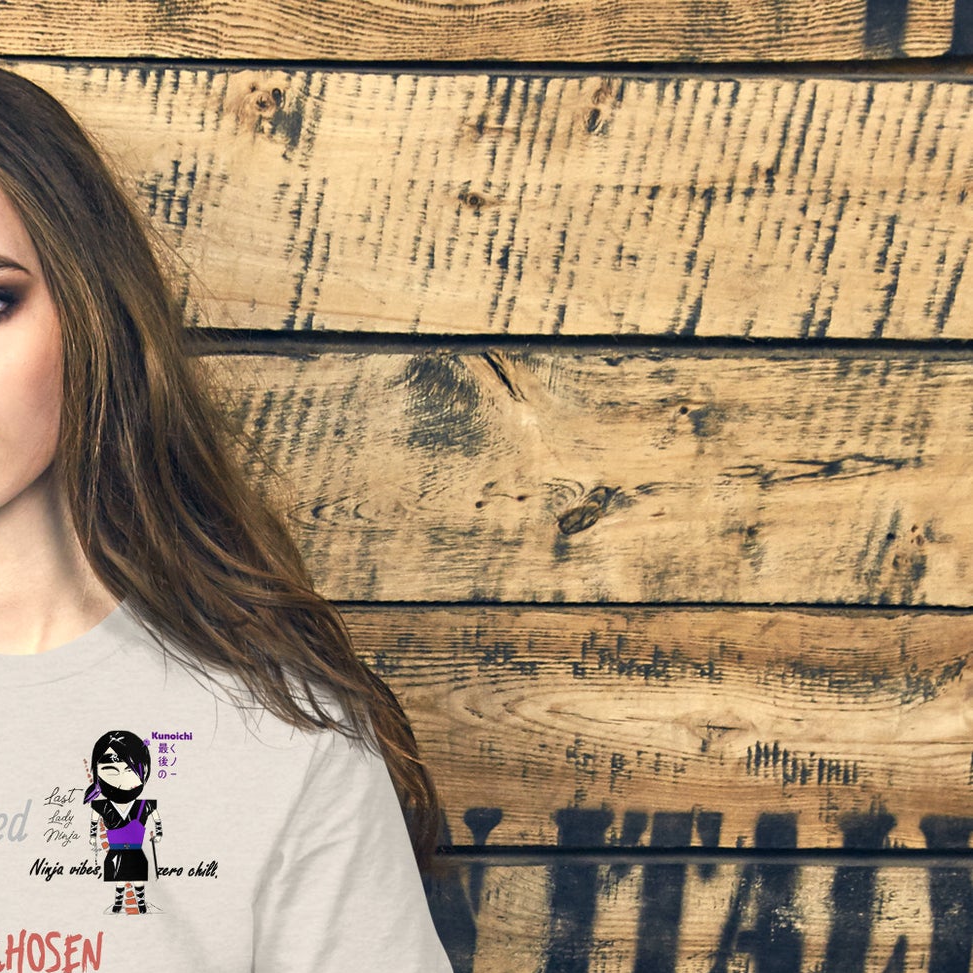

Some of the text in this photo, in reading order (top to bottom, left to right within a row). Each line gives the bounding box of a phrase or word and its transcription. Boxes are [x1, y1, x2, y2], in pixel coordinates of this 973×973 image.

[151, 731, 193, 740] Kunoichi
[43, 786, 84, 807] Last
[48, 809, 75, 829] Lady
[43, 828, 81, 848] Ninja
[29, 857, 219, 881] Ninja vibes, zero chill.
